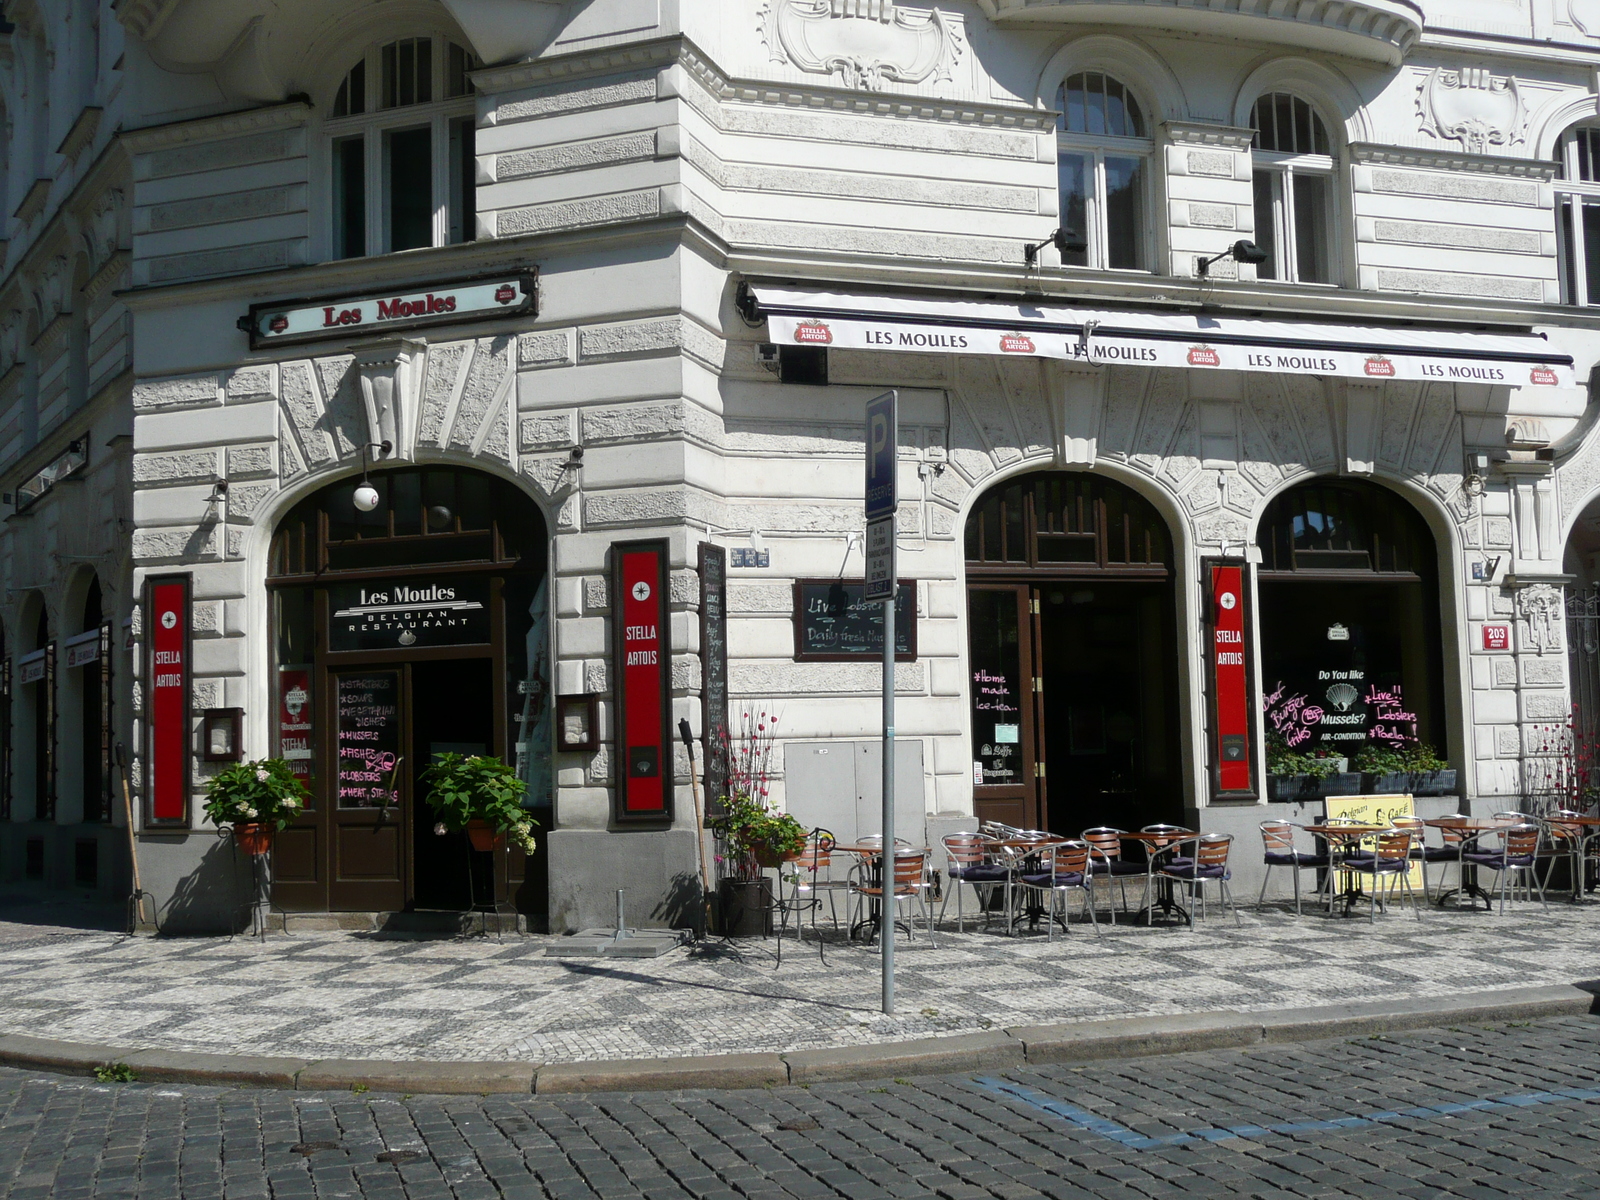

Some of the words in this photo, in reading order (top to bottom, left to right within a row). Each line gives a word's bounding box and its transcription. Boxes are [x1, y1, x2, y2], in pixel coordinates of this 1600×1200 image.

[323, 307, 362, 327] Les
[377, 294, 456, 321] Moules
[801, 333, 827, 341] ARTOIS
[865, 331, 893, 345] LES
[899, 333, 968, 348] MOULES
[1065, 342, 1088, 357] LES
[1093, 346, 1157, 361] MOULES
[1248, 354, 1272, 367] LES
[1277, 356, 1337, 371] MOULES
[1421, 364, 1444, 376] LES
[1449, 366, 1505, 380] MOULES
[871, 412, 888, 479] P
[360, 588, 388, 605] Les
[394, 583, 456, 603] Moules
[808, 598, 838, 613] Live
[368, 611, 447, 622] BELGIAN
[349, 618, 468, 632] RESTAURANT
[625, 625, 657, 640] STELLA
[807, 624, 838, 648] Daily
[840, 626, 865, 642] fresh
[1216, 630, 1242, 643] STELLA
[1488, 627, 1505, 639] 203
[156, 651, 181, 664] STELLA
[627, 650, 657, 666] ARTOIS
[1217, 652, 1243, 665] ARTOIS
[156, 673, 181, 687] ARTOIS
[1318, 670, 1330, 680] Do
[1332, 670, 1348, 680] You
[1349, 670, 1365, 680] like
[981, 685, 1010, 695] made
[1321, 713, 1366, 725] Mussels?
[346, 730, 379, 741] MUSSELS
[1321, 732, 1367, 741] AIR-CONDITION
[281, 737, 307, 751] STELLA
[346, 747, 377, 760] FISHES
[346, 771, 381, 782] LOBSTERS
